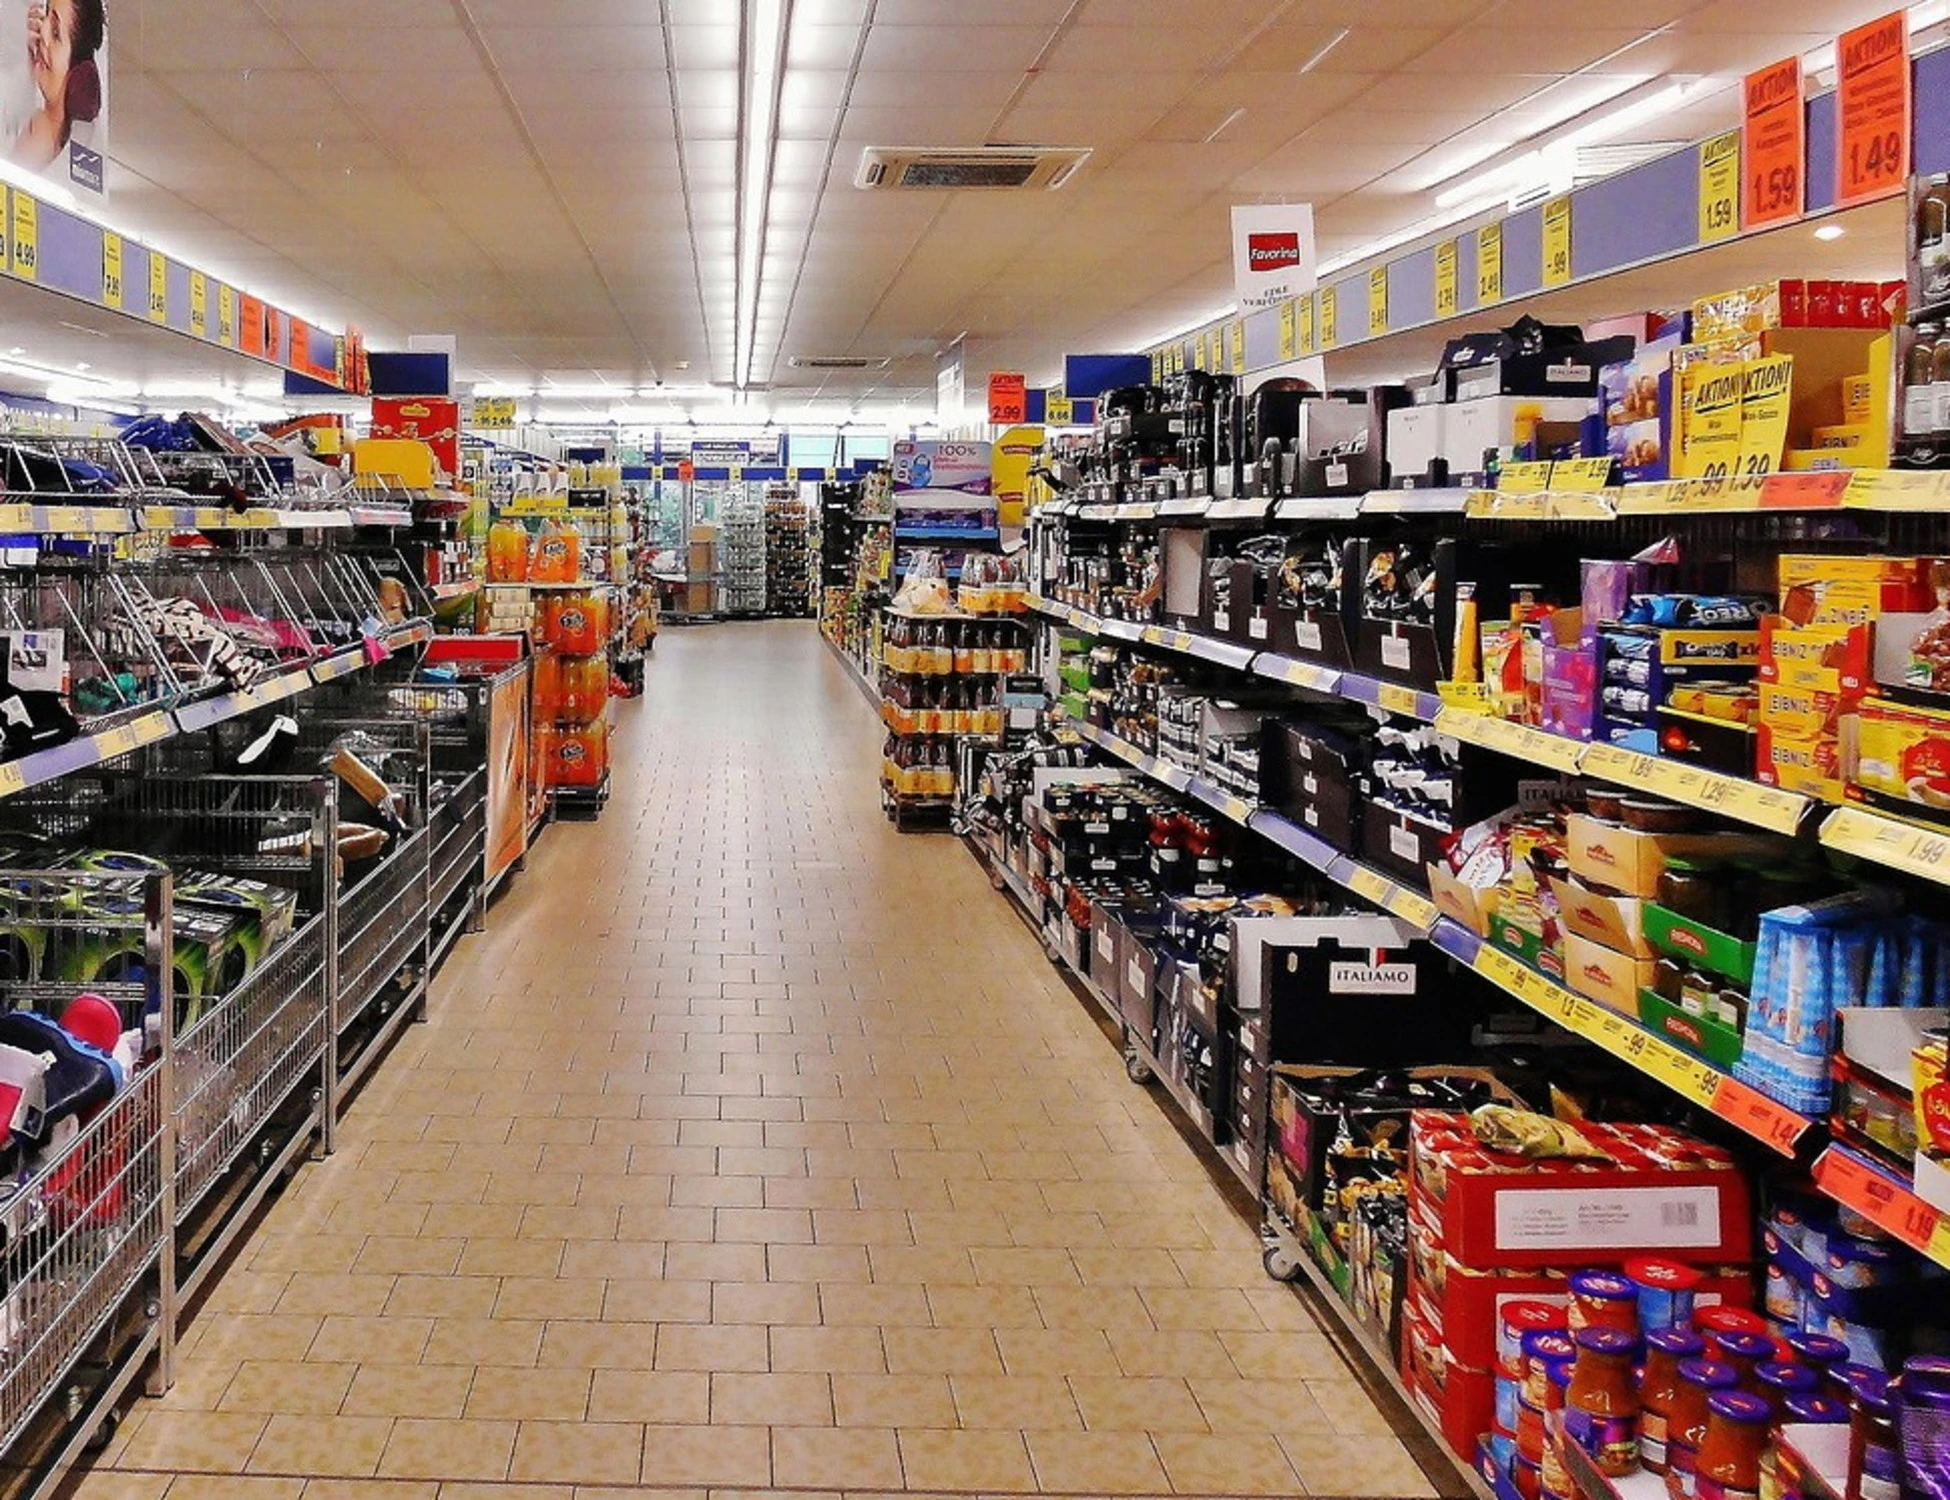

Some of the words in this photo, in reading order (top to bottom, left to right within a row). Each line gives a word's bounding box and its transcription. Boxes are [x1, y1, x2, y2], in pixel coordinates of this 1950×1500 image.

[1850, 131, 1900, 185] 1.49
[1754, 164, 1797, 214] 1.59
[1706, 198, 1732, 230] 1.59
[1250, 246, 1299, 261] Favorina
[993, 405, 1021, 420] 2.99
[939, 444, 978, 457] 100%
[1729, 452, 1771, 492] 1.39
[1772, 641, 1807, 660] EIBNIZ
[1772, 745, 1809, 768] EIBNIZ
[1906, 833, 1946, 866] 1.99
[1336, 969, 1409, 984] ITALIAMO
[1623, 1032, 1647, 1056] -.99
[1693, 1070, 1720, 1096] -.99
